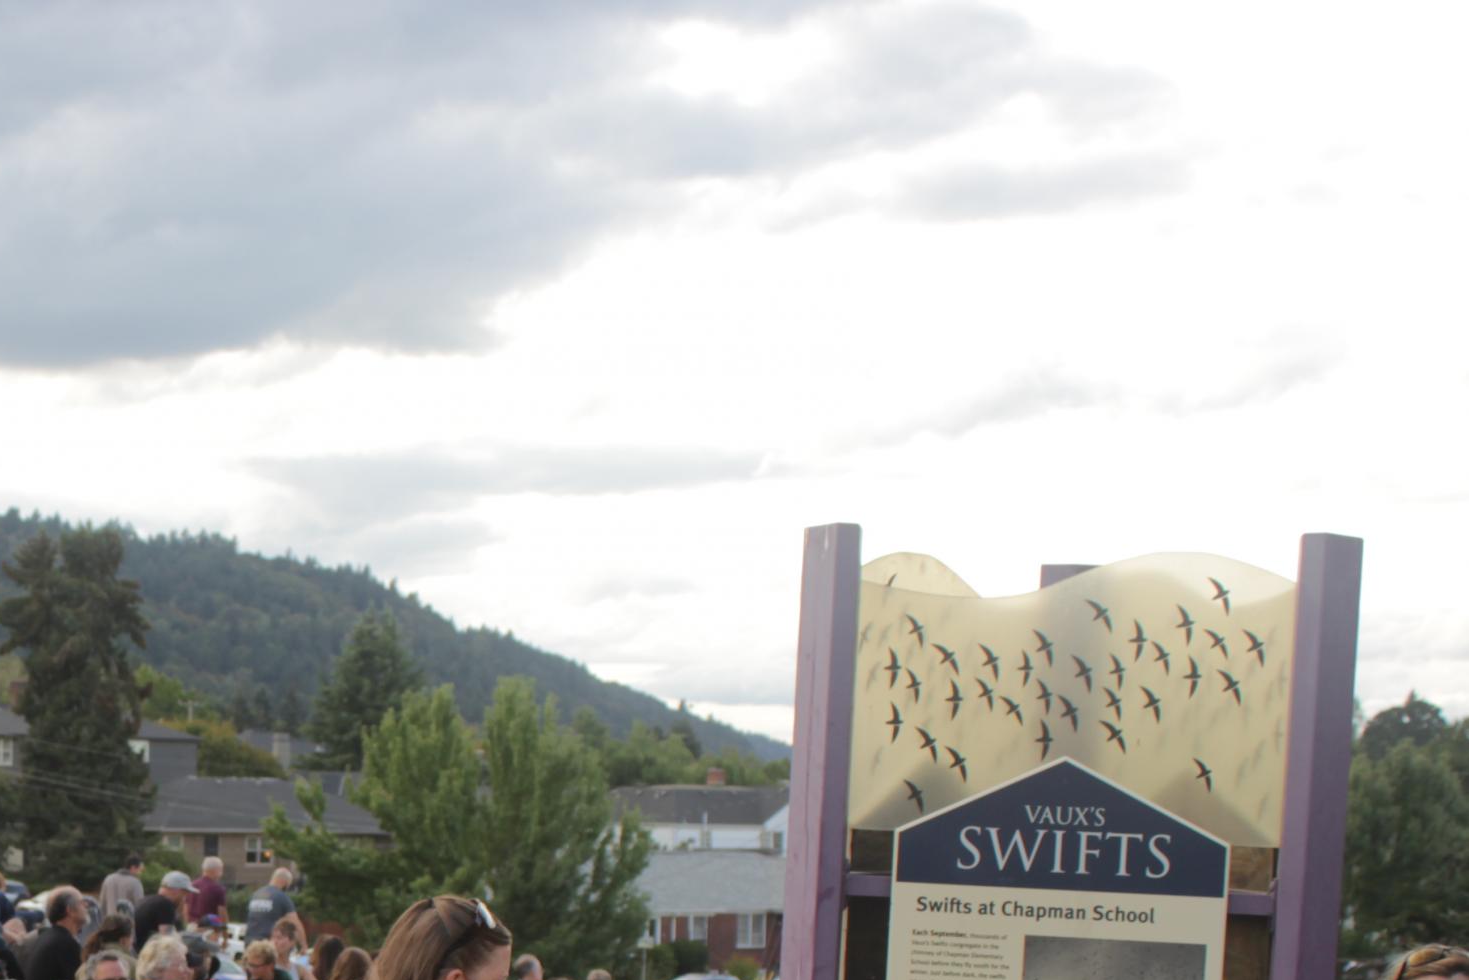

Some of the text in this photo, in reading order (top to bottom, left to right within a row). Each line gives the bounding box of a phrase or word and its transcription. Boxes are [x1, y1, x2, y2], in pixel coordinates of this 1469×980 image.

[1025, 804, 1106, 827] VAUX'S
[956, 825, 1172, 880] SWIFTS
[916, 896, 1155, 924] Swifts at Chapman School
[930, 930, 968, 939] September,
